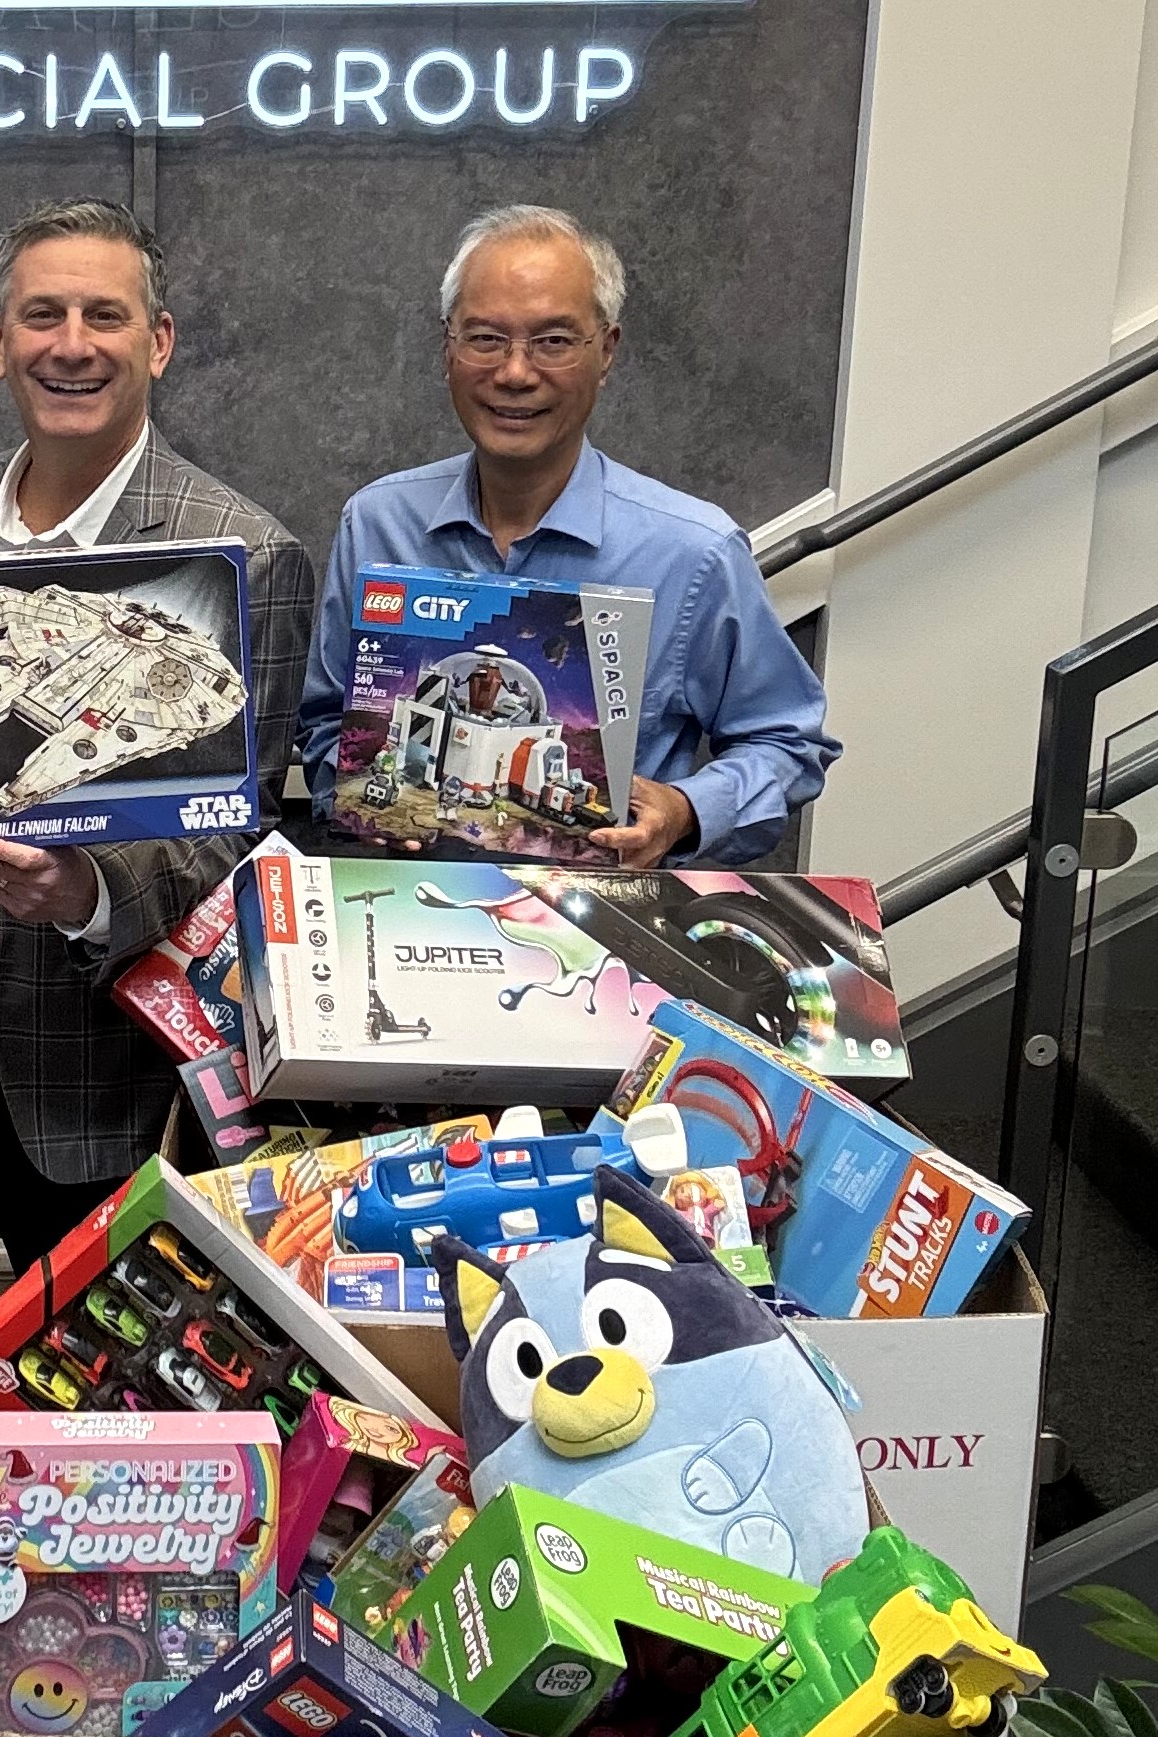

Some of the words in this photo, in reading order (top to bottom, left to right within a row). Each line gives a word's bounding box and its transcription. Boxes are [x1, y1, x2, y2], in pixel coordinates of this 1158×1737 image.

[246, 47, 637, 128] GROUP
[364, 591, 404, 613] LEGO
[412, 594, 471, 622] CITY
[356, 655, 383, 664] 60439
[358, 638, 381, 652] 6+
[354, 673, 373, 686] 560
[598, 632, 630, 721] SPACE
[180, 795, 251, 815] STAR
[180, 810, 248, 831] WARS
[64, 816, 108, 833] FALCON
[268, 866, 288, 933] JETSON
[198, 925, 239, 981] Music
[394, 945, 504, 965] JUPITER
[869, 1169, 941, 1304] STUNT
[908, 1215, 952, 1290] TRACKS
[335, 1258, 394, 1269] FRIENDSHIP
[855, 1434, 985, 1472] ONLY
[49, 1459, 238, 1483] PERSONALIZED
[18, 1484, 243, 1534] Positivity
[38, 1524, 221, 1574] Jewelry
[540, 1532, 573, 1550] Leap
[548, 1547, 582, 1567] Frog
[7, 1587, 19, 1598] of
[494, 1574, 512, 1607] Frog
[500, 1561, 518, 1591] Leap
[636, 1555, 706, 1593] Musical
[706, 1580, 782, 1620] Rainbow
[452, 1576, 468, 1620] Tea
[646, 1576, 704, 1621] Tea
[702, 1594, 789, 1657] Party
[459, 1611, 483, 1682] Party
[475, 1610, 493, 1667] Rainbow
[542, 1678, 582, 1692] Frog
[547, 1666, 588, 1681] Leap
[213, 1667, 268, 1714] Disney
[277, 1690, 338, 1730] LEGO
